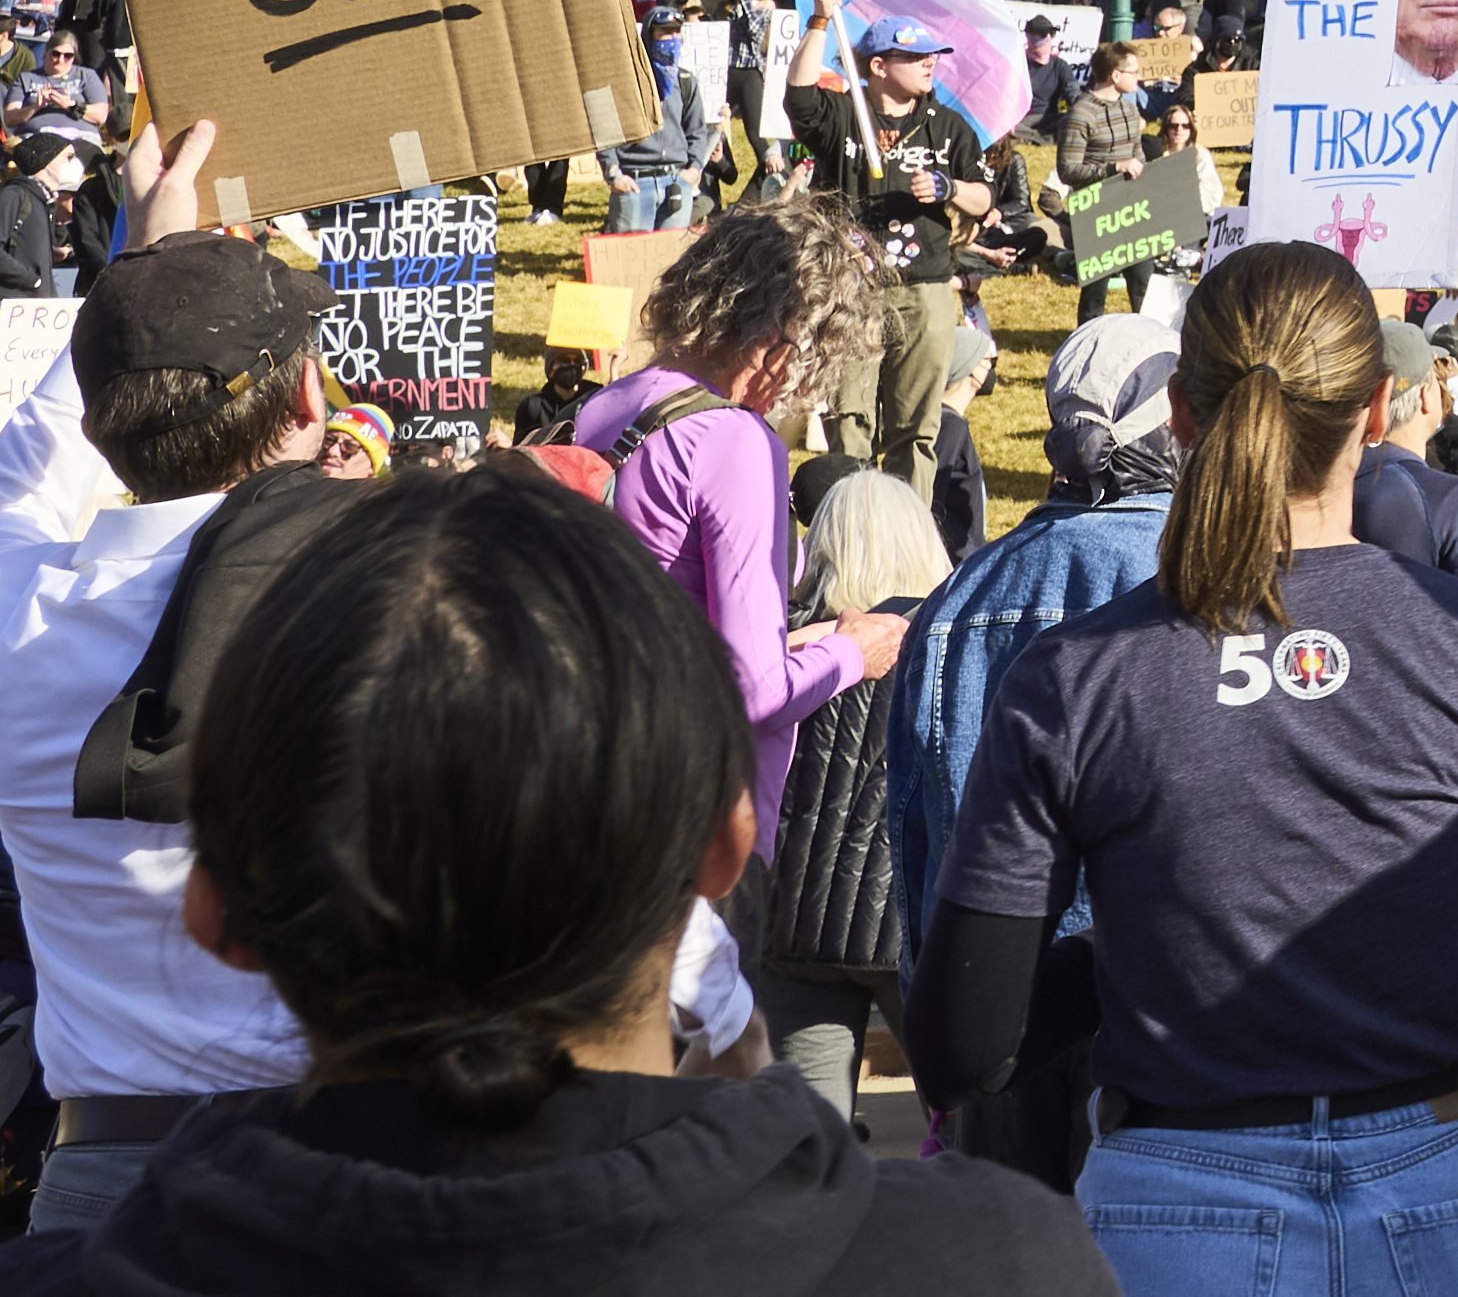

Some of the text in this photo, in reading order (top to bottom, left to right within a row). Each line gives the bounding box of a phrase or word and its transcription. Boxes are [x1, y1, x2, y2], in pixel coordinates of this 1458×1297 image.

[1139, 42, 1182, 56] STOP
[1142, 64, 1181, 77] MUSK
[1214, 81, 1239, 95] GET
[1201, 114, 1240, 128] OF OUR
[1272, 100, 1458, 177] THRUSSY
[369, 198, 457, 229] THERE
[458, 195, 497, 226] IS
[1068, 183, 1102, 216] FDT
[1095, 200, 1151, 237] FUCK
[1212, 213, 1245, 249] There
[318, 224, 497, 262] NO JUSTICE FOR
[1078, 230, 1175, 281] FASCISTS
[320, 260, 381, 290] THE
[8, 305, 79, 331] PRO
[329, 283, 494, 320] ET THERE BE
[319, 314, 484, 354] NO PEACE
[322, 347, 482, 383] FOR THE
[414, 416, 479, 439] ZAPATA
